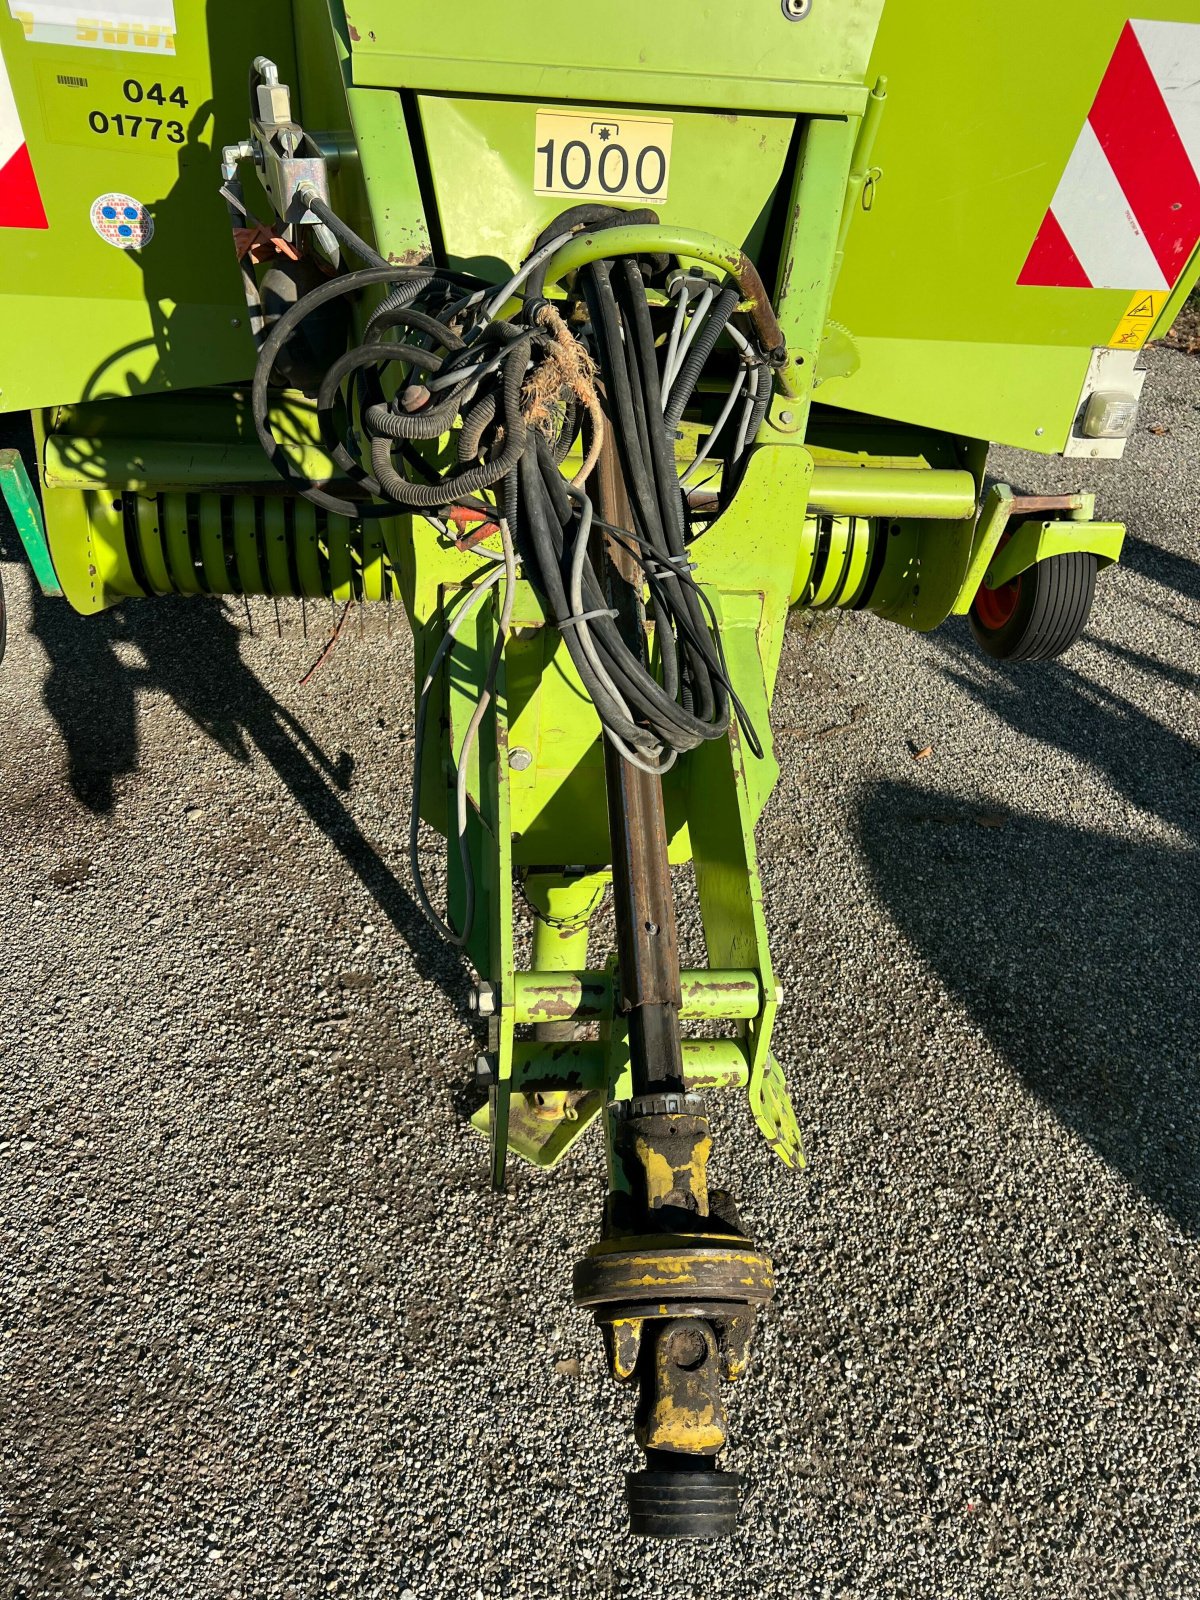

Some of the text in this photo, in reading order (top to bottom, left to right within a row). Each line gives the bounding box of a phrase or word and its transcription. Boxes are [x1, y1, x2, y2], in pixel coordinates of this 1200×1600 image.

[123, 79, 189, 108] 044
[88, 111, 185, 143] 01773
[537, 139, 666, 195] 1000
